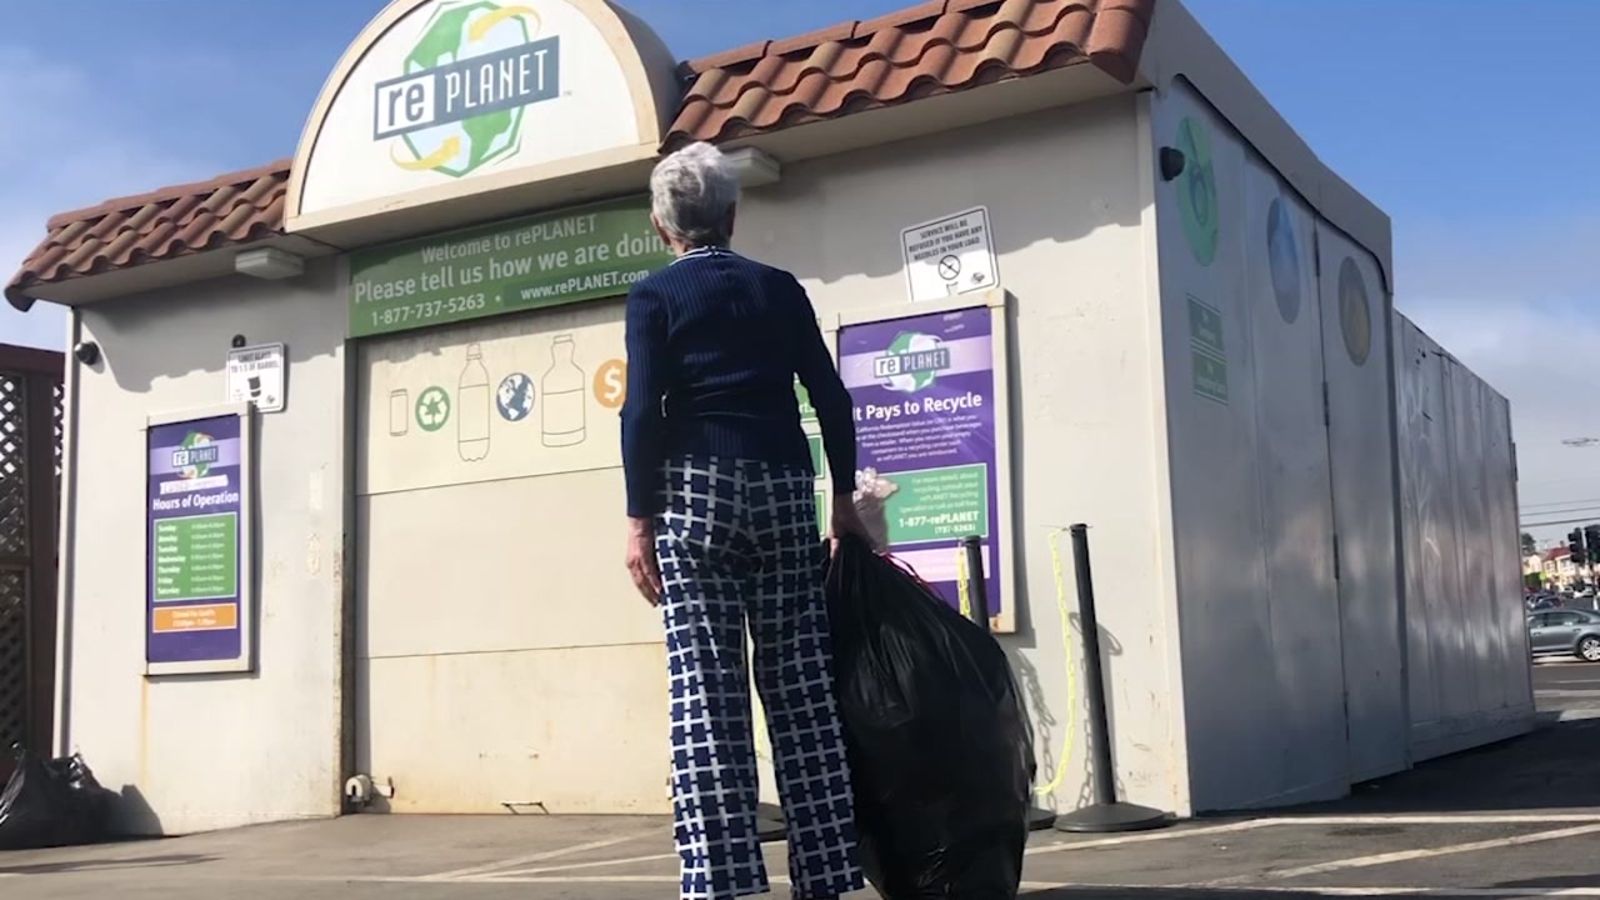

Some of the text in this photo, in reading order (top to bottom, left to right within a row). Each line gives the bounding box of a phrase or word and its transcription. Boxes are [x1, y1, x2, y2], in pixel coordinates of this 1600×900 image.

[445, 49, 548, 112] PLANET
[421, 214, 598, 264] Welcome to rePLANET
[909, 239, 934, 252] REFUSED
[941, 234, 954, 243] YOU
[954, 229, 970, 238] HAVE
[971, 225, 982, 235] ANY
[920, 219, 968, 239] SERVICE WILL BE
[947, 241, 964, 252] YOUR
[964, 236, 980, 247] LOAD
[355, 230, 674, 303] Please tell us how we are doin
[521, 269, 650, 300] www.rePLANET.com
[371, 293, 485, 326] 1-877-737-5263
[903, 350, 946, 371] PLANET
[866, 404, 901, 422] Pays
[904, 401, 920, 415] to
[924, 391, 983, 413] Recycle
[153, 489, 239, 510] Hours of Operation
[898, 509, 980, 529] 1-877-rePLANET
